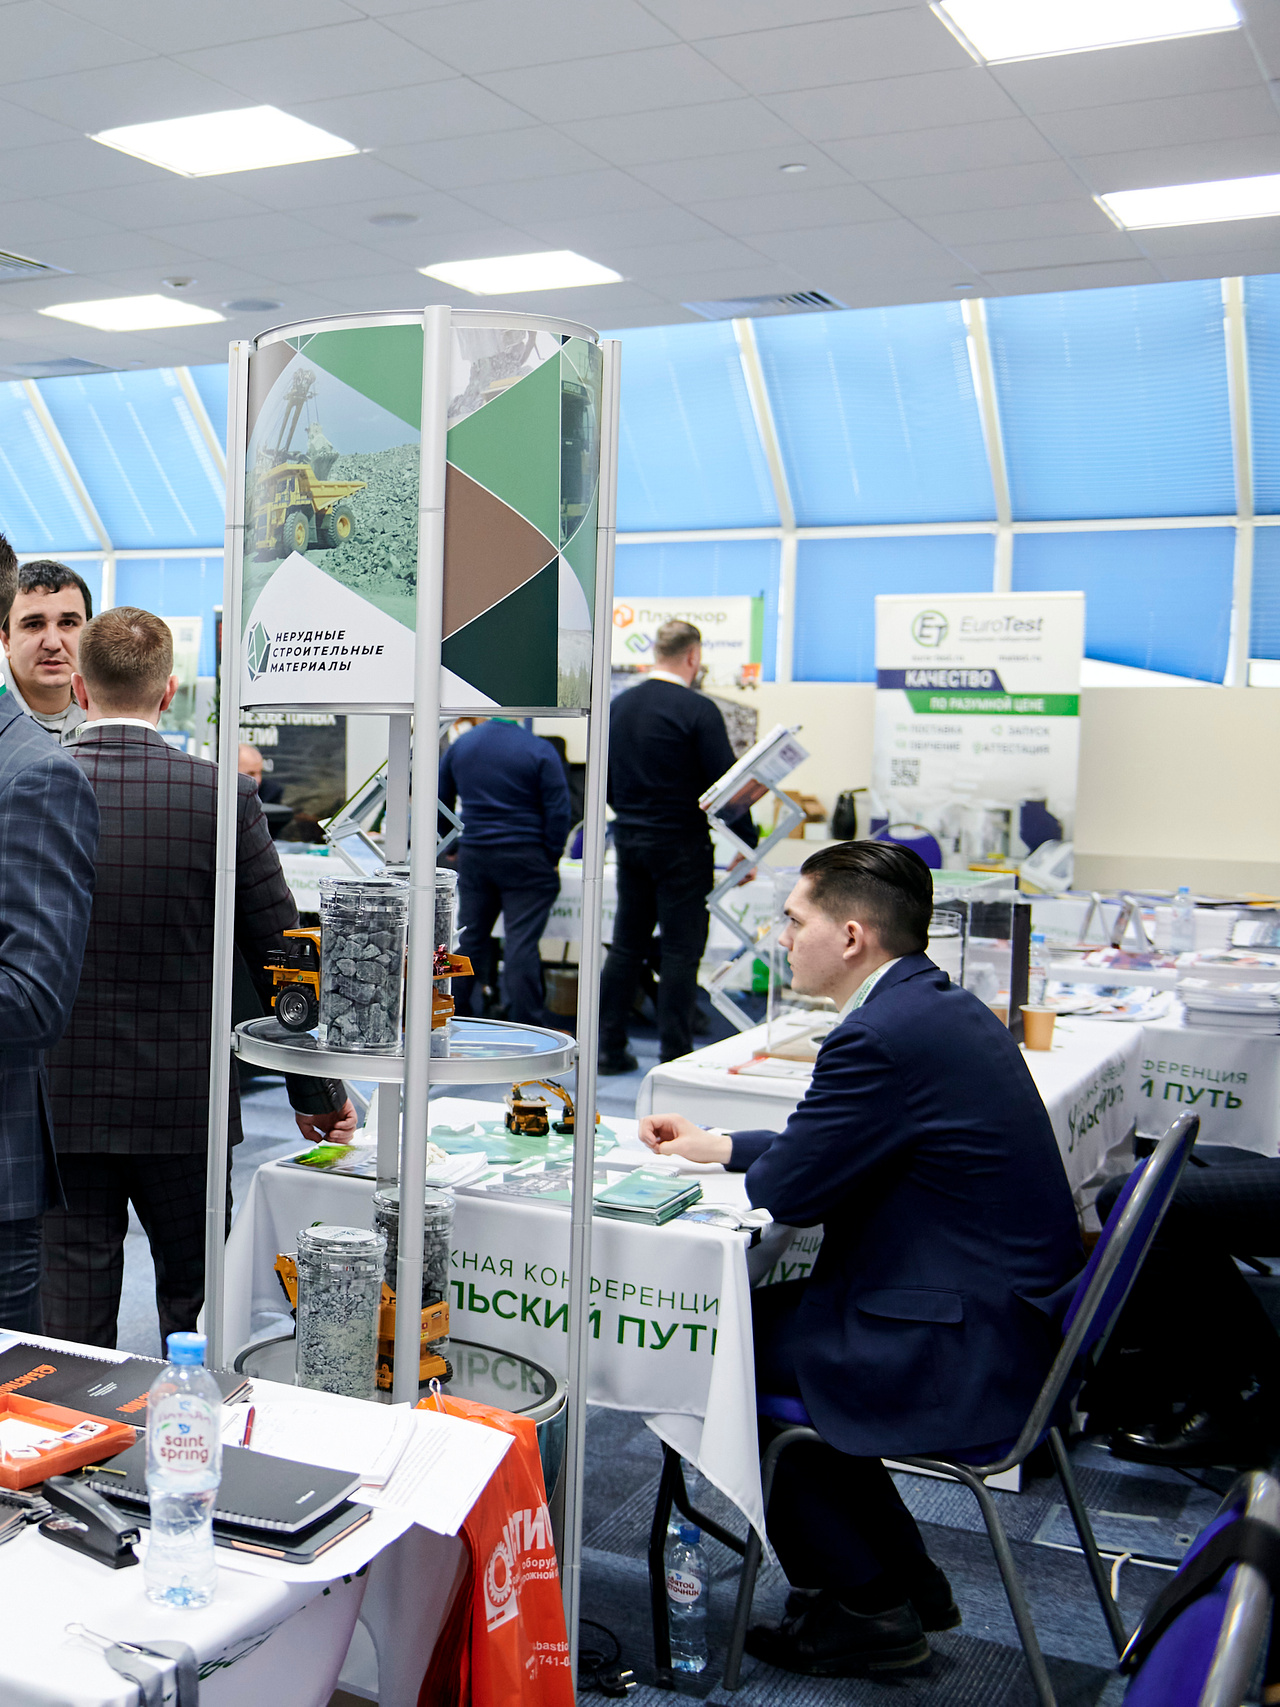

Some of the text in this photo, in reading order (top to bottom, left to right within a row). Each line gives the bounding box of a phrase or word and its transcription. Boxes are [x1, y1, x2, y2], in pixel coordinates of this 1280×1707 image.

[275, 630, 346, 643] НЕРУДНЫЕ
[272, 645, 385, 658] СТРОИТЕЛЬНЫЕ
[270, 661, 352, 673] МАТЕРИАЛЫ
[905, 669, 993, 688] КАЧЕСТВО
[930, 695, 1045, 713] ПО РАЗУМНОЙ ЦЕНЕ
[1163, 1082, 1243, 1109] ПУТЬ
[165, 1434, 205, 1448] saint
[160, 1447, 209, 1463] spring
